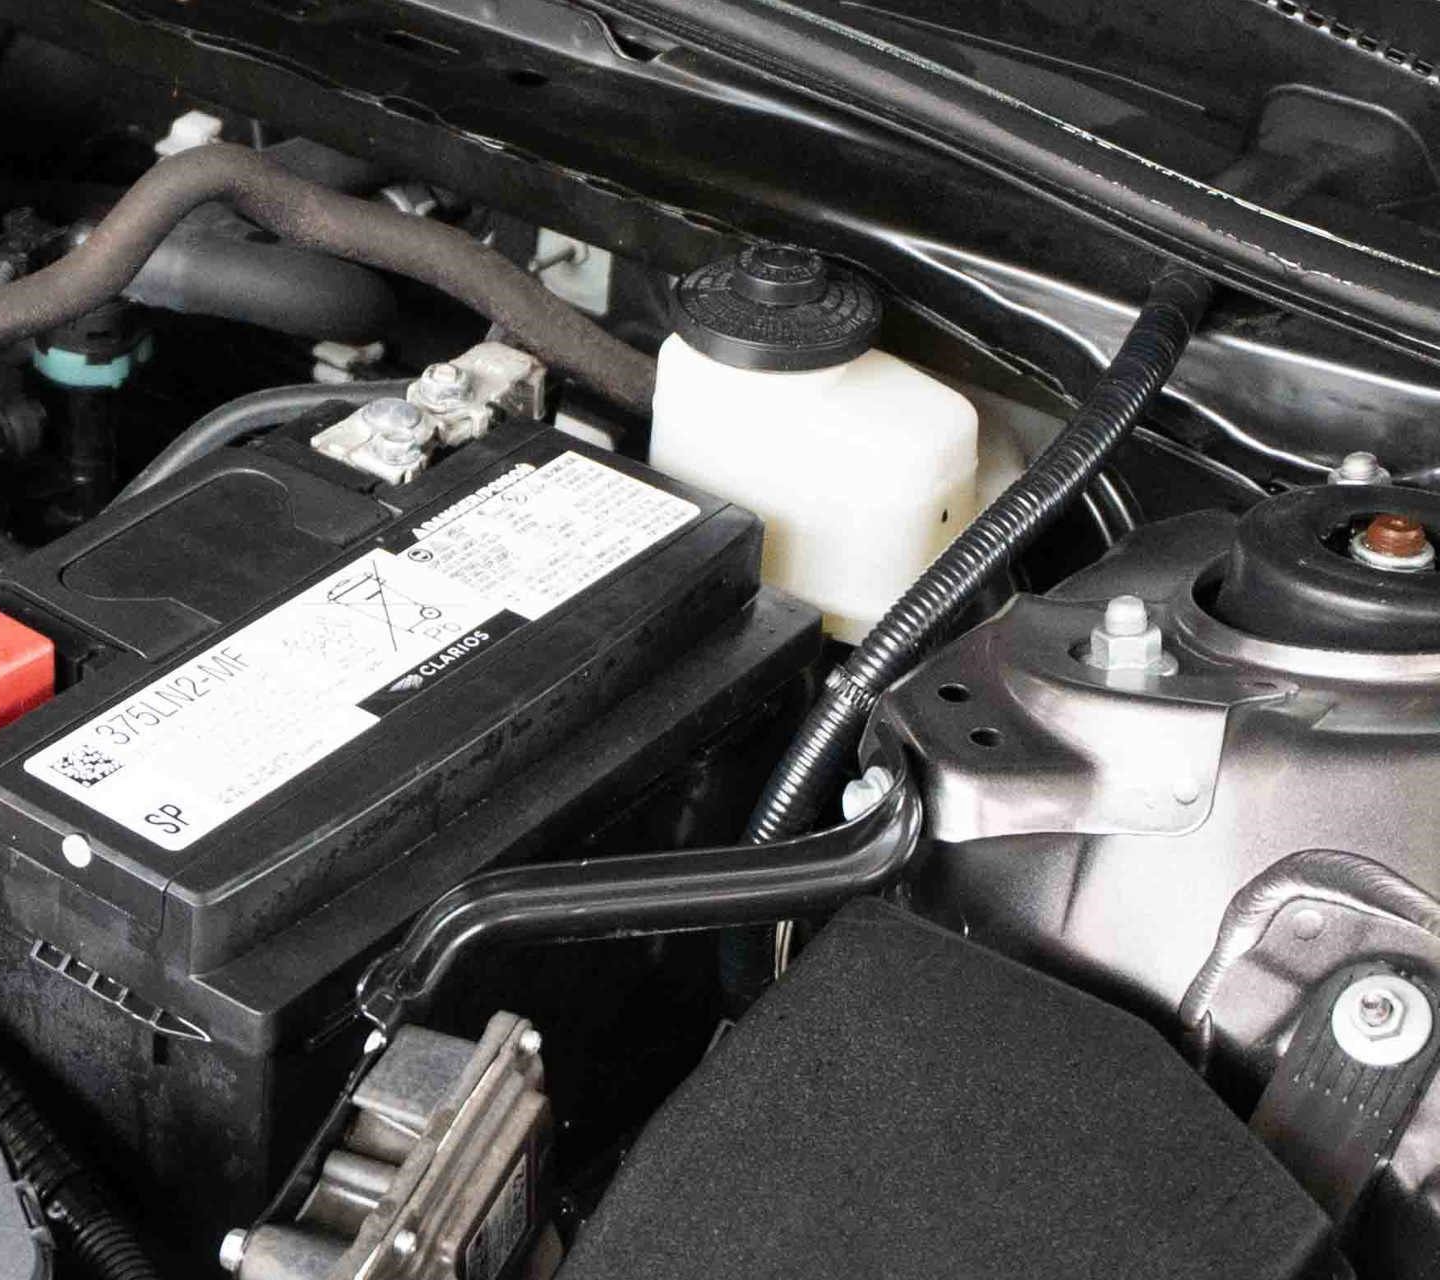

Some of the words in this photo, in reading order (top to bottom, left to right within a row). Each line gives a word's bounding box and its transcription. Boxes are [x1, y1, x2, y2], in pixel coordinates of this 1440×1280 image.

[419, 629, 490, 676] CLARIOS
[94, 646, 249, 745] 375LN2-MF
[143, 803, 190, 834] SP
